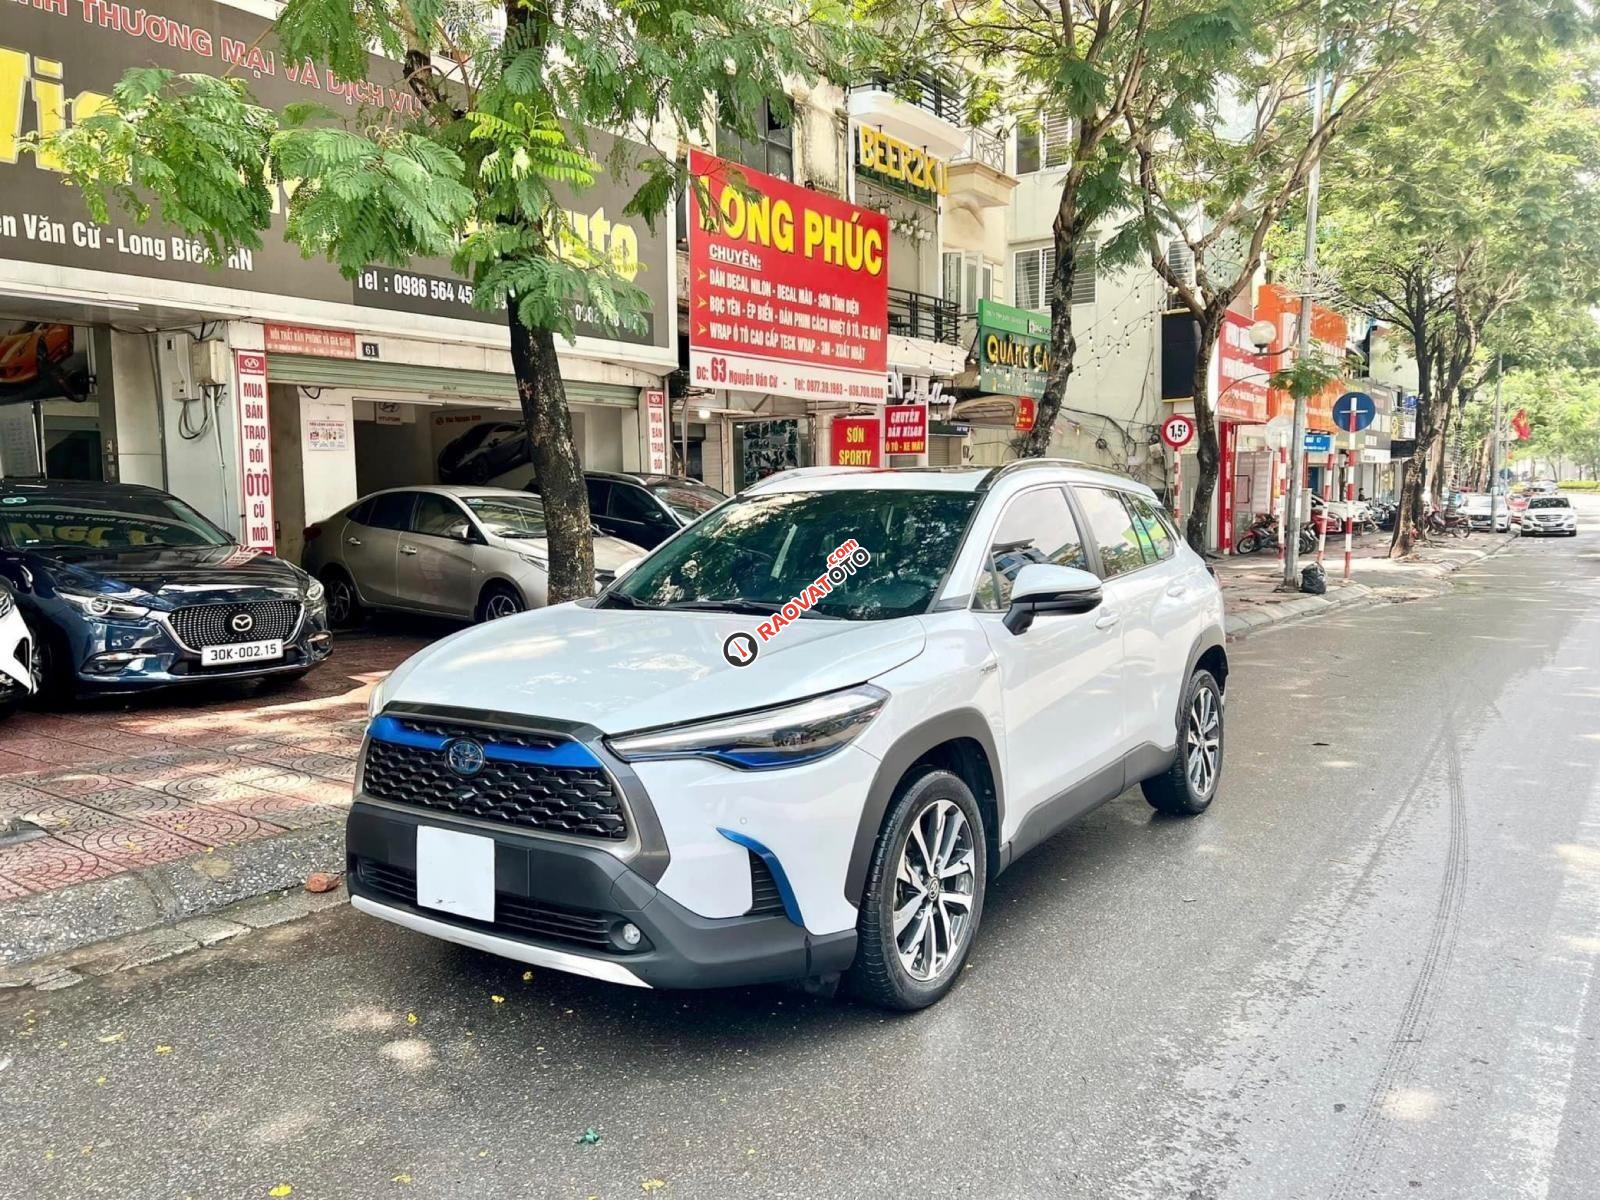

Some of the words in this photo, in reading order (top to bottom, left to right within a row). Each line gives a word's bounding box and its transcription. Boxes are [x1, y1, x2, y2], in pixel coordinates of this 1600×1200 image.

[82, 0, 213, 56] THƯƠNG
[23, 213, 66, 244] Văn
[72, 218, 101, 249] Cừ
[117, 228, 166, 261] Long
[804, 206, 883, 276] PHÚC
[709, 244, 761, 269] CHUYÊN:
[394, 273, 427, 298] 0986
[430, 280, 455, 302] 564
[709, 267, 725, 288] DÁN
[727, 272, 750, 293] DECAL
[710, 321, 731, 341] WRAP
[365, 345, 376, 356] 61
[711, 356, 727, 383] 63
[244, 383, 263, 398] MUA
[244, 425, 266, 440] TRAO
[839, 449, 871, 466] SPORTY
[252, 523, 268, 541] MỚI
[210, 643, 277, 661] 30K-002.15
